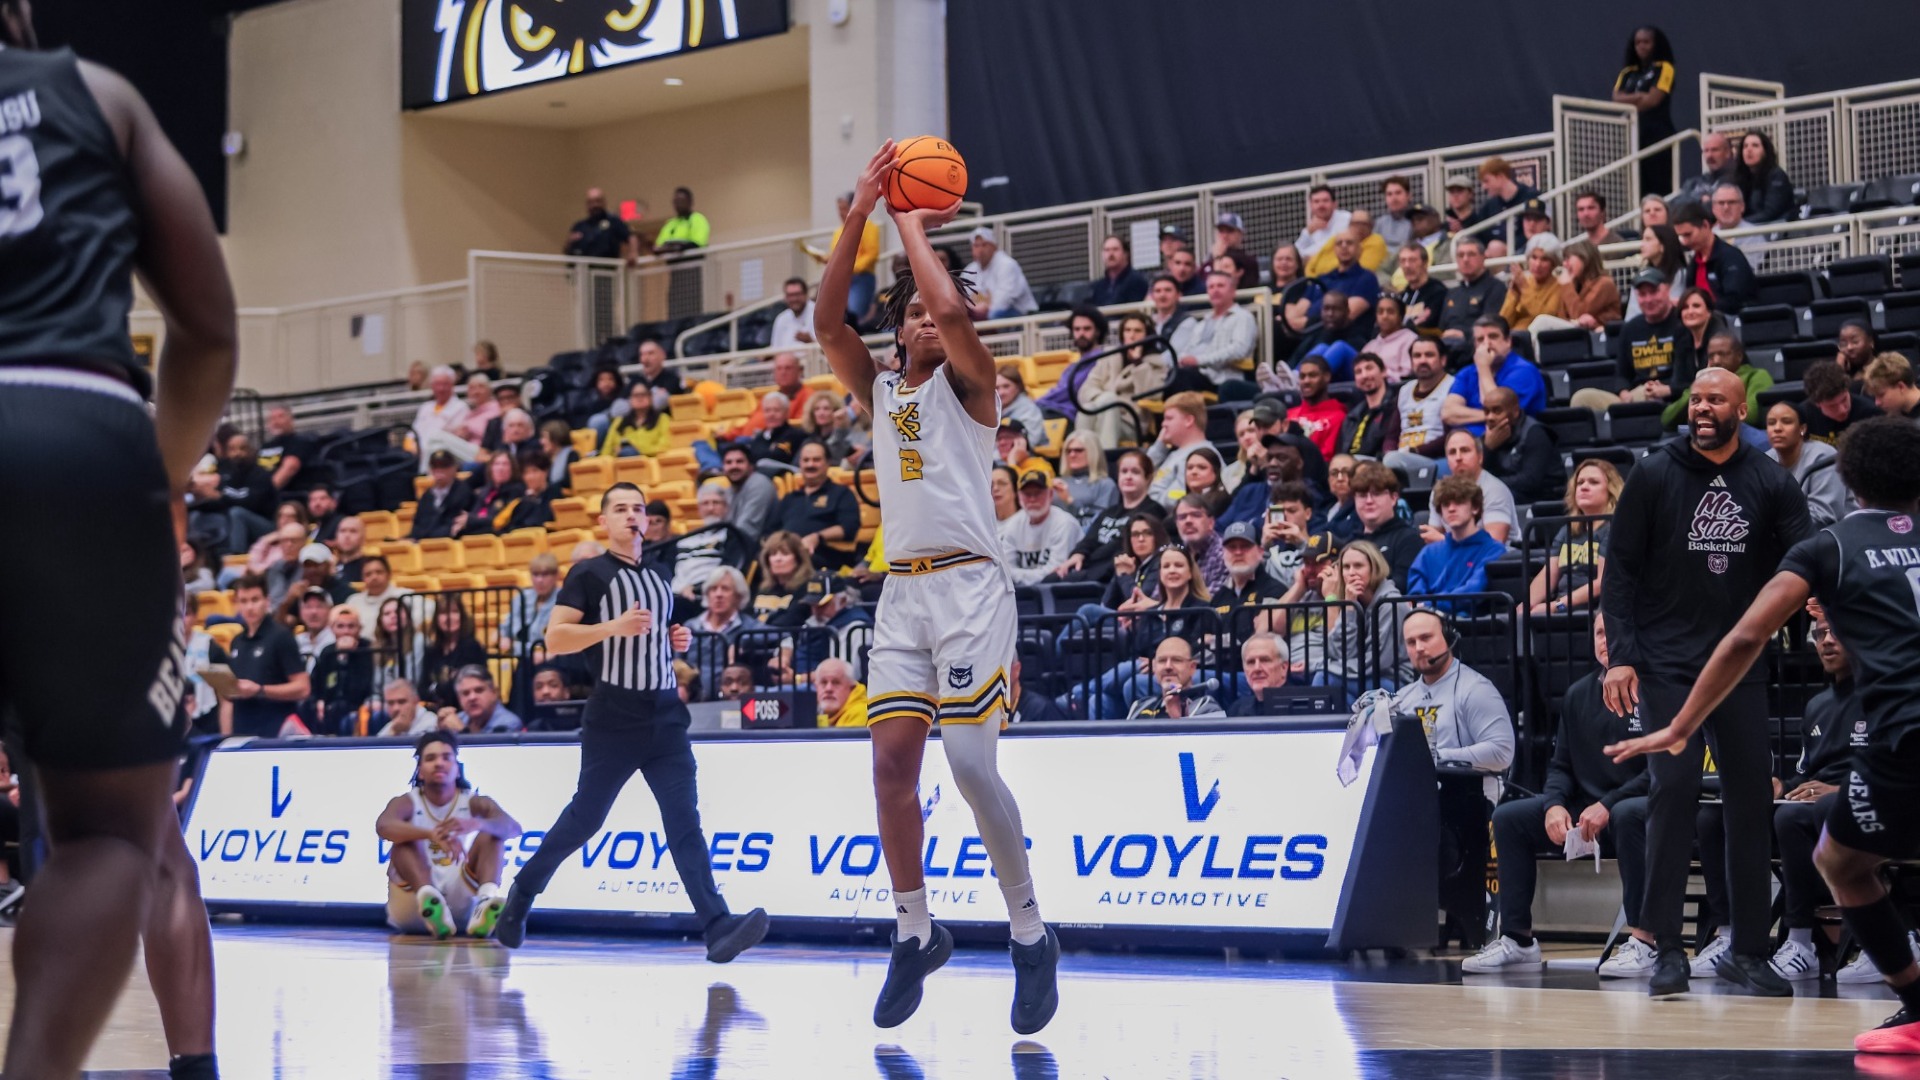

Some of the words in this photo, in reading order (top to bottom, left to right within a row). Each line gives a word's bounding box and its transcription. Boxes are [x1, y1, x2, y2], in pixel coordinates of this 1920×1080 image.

[0, 89, 41, 134] SU
[899, 448, 924, 482] 2
[1694, 491, 1742, 519] Mo
[1688, 514, 1750, 542] State
[1688, 541, 1746, 553] Basketball
[1864, 546, 1920, 569] R.WILL
[754, 699, 780, 720] POSS
[201, 829, 349, 865] VOYLES
[581, 831, 774, 872] VOYES
[809, 834, 1033, 879] VOLE
[1073, 834, 1328, 880] VOYLES
[598, 880, 726, 896] AUTOMOE
[829, 887, 980, 904] AUTOTIVE
[1098, 891, 1269, 908] AUTOMOTIVE
